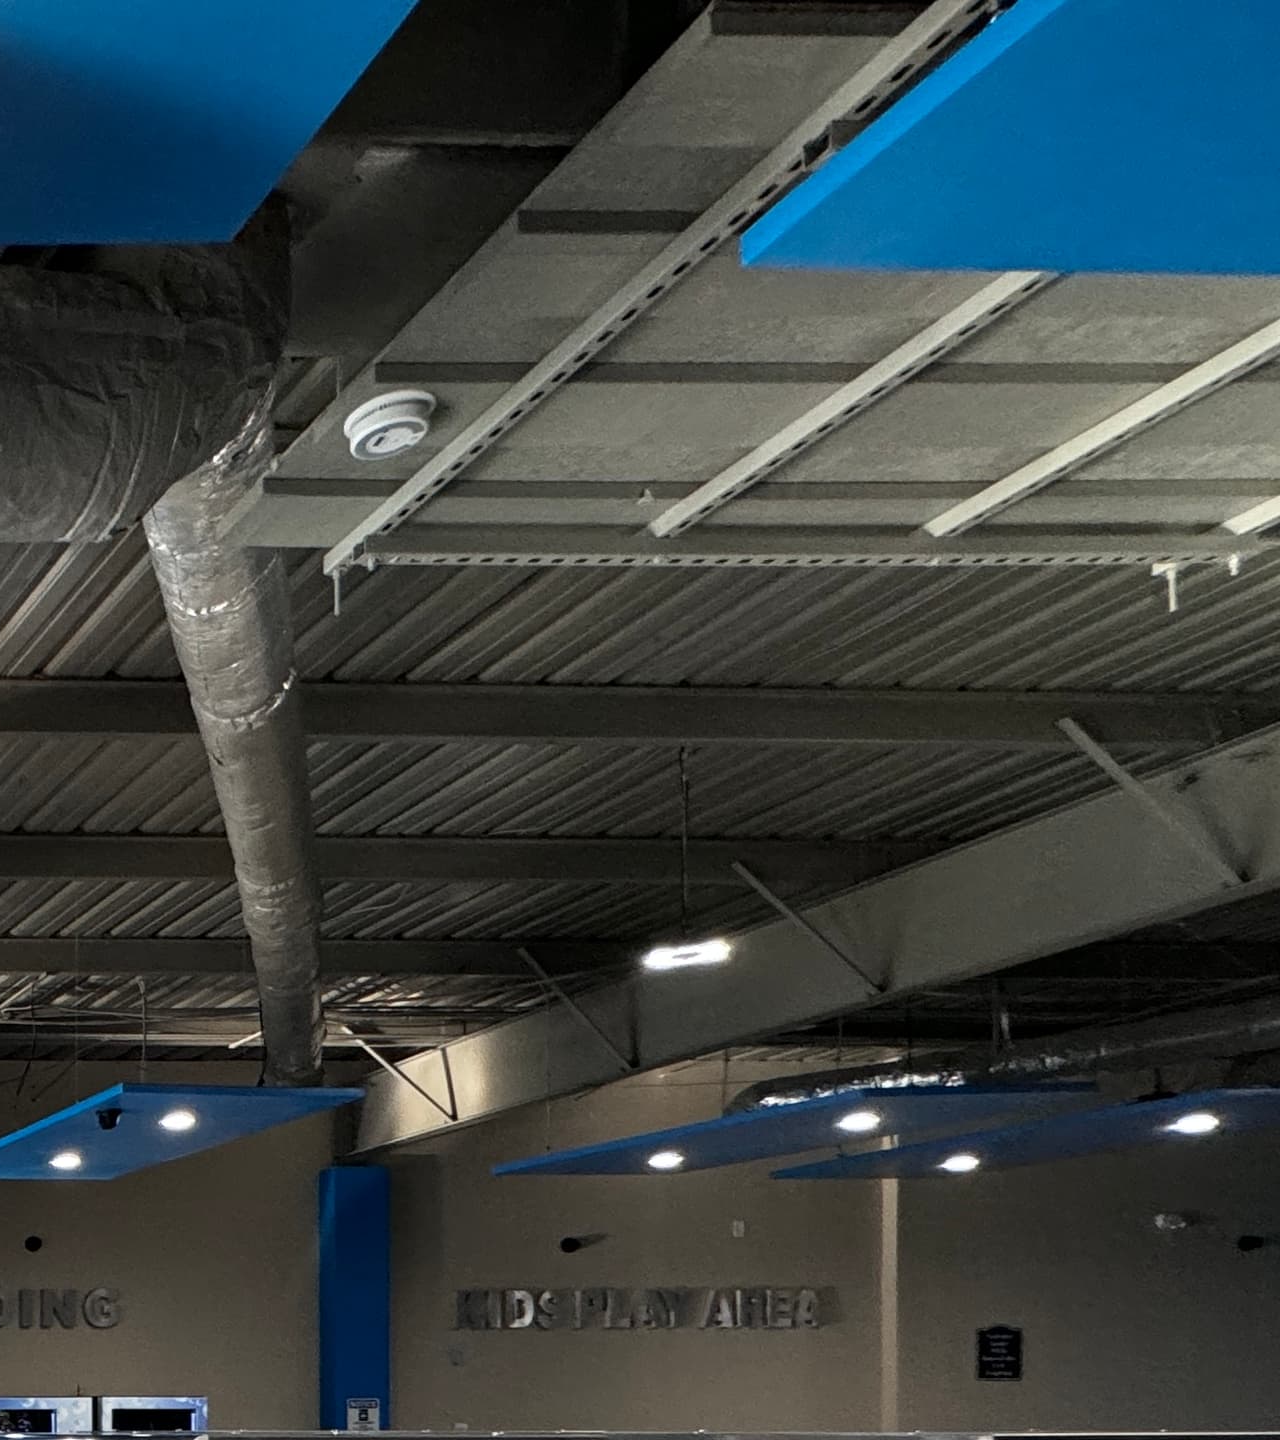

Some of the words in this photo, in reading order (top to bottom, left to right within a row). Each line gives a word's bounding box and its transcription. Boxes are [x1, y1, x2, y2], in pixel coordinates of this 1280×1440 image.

[456, 1287, 559, 1329] KIDS
[574, 1287, 680, 1329] PLAY
[701, 1287, 821, 1329] AREA
